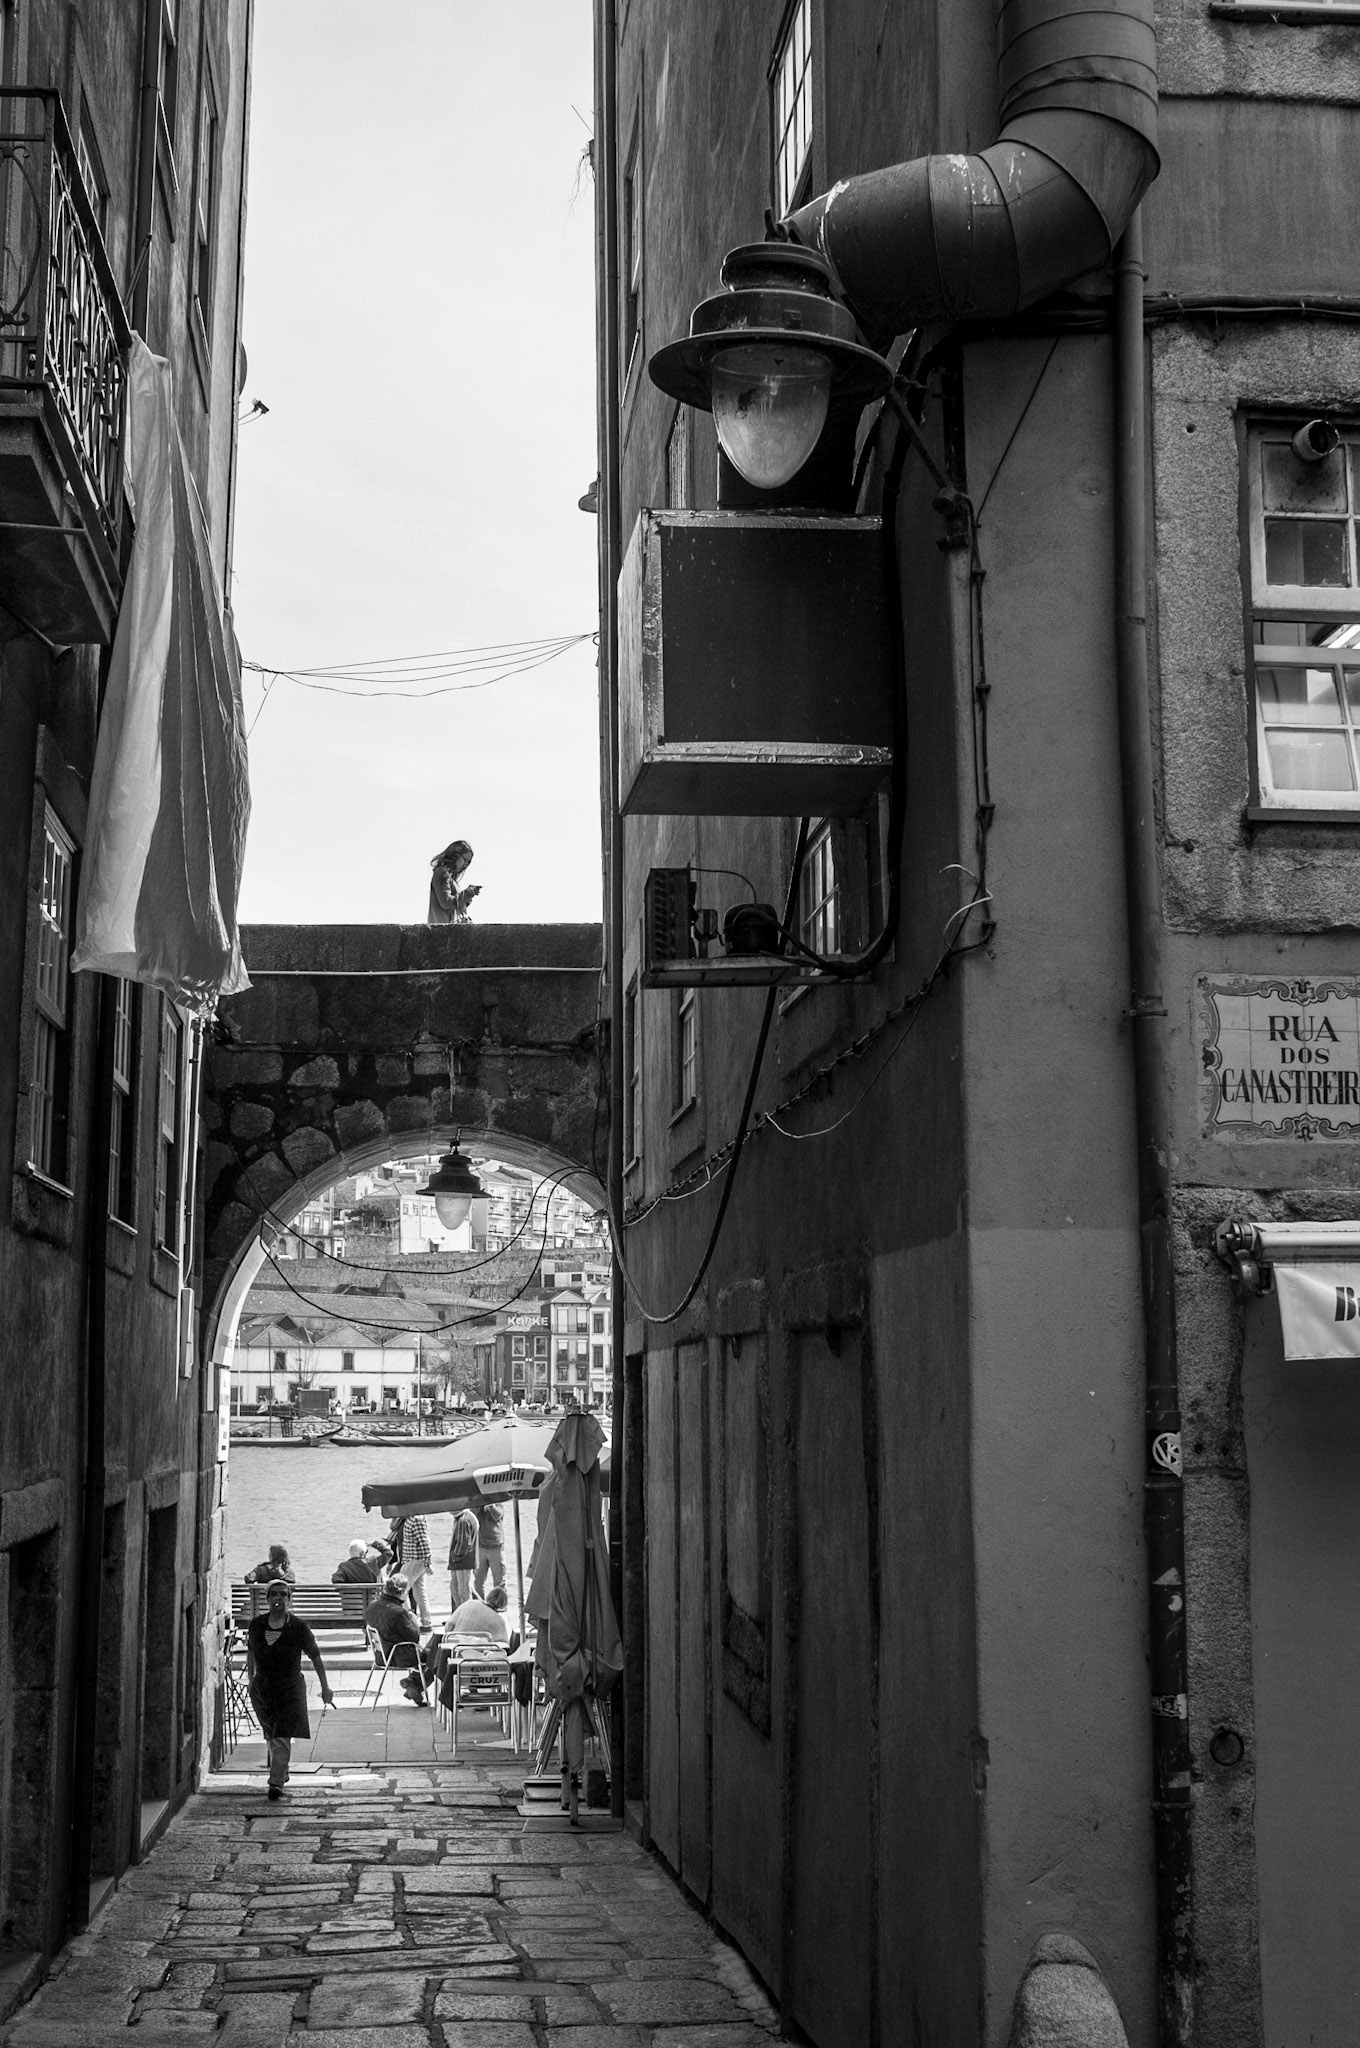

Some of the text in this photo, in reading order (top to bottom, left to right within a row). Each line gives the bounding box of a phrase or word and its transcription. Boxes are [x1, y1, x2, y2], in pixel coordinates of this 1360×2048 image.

[1268, 1015, 1341, 1042] RUA
[1280, 1047, 1330, 1064] DOS
[1221, 1068, 1360, 1105] CANASTREIR
[507, 1316, 548, 1326] KOPKE
